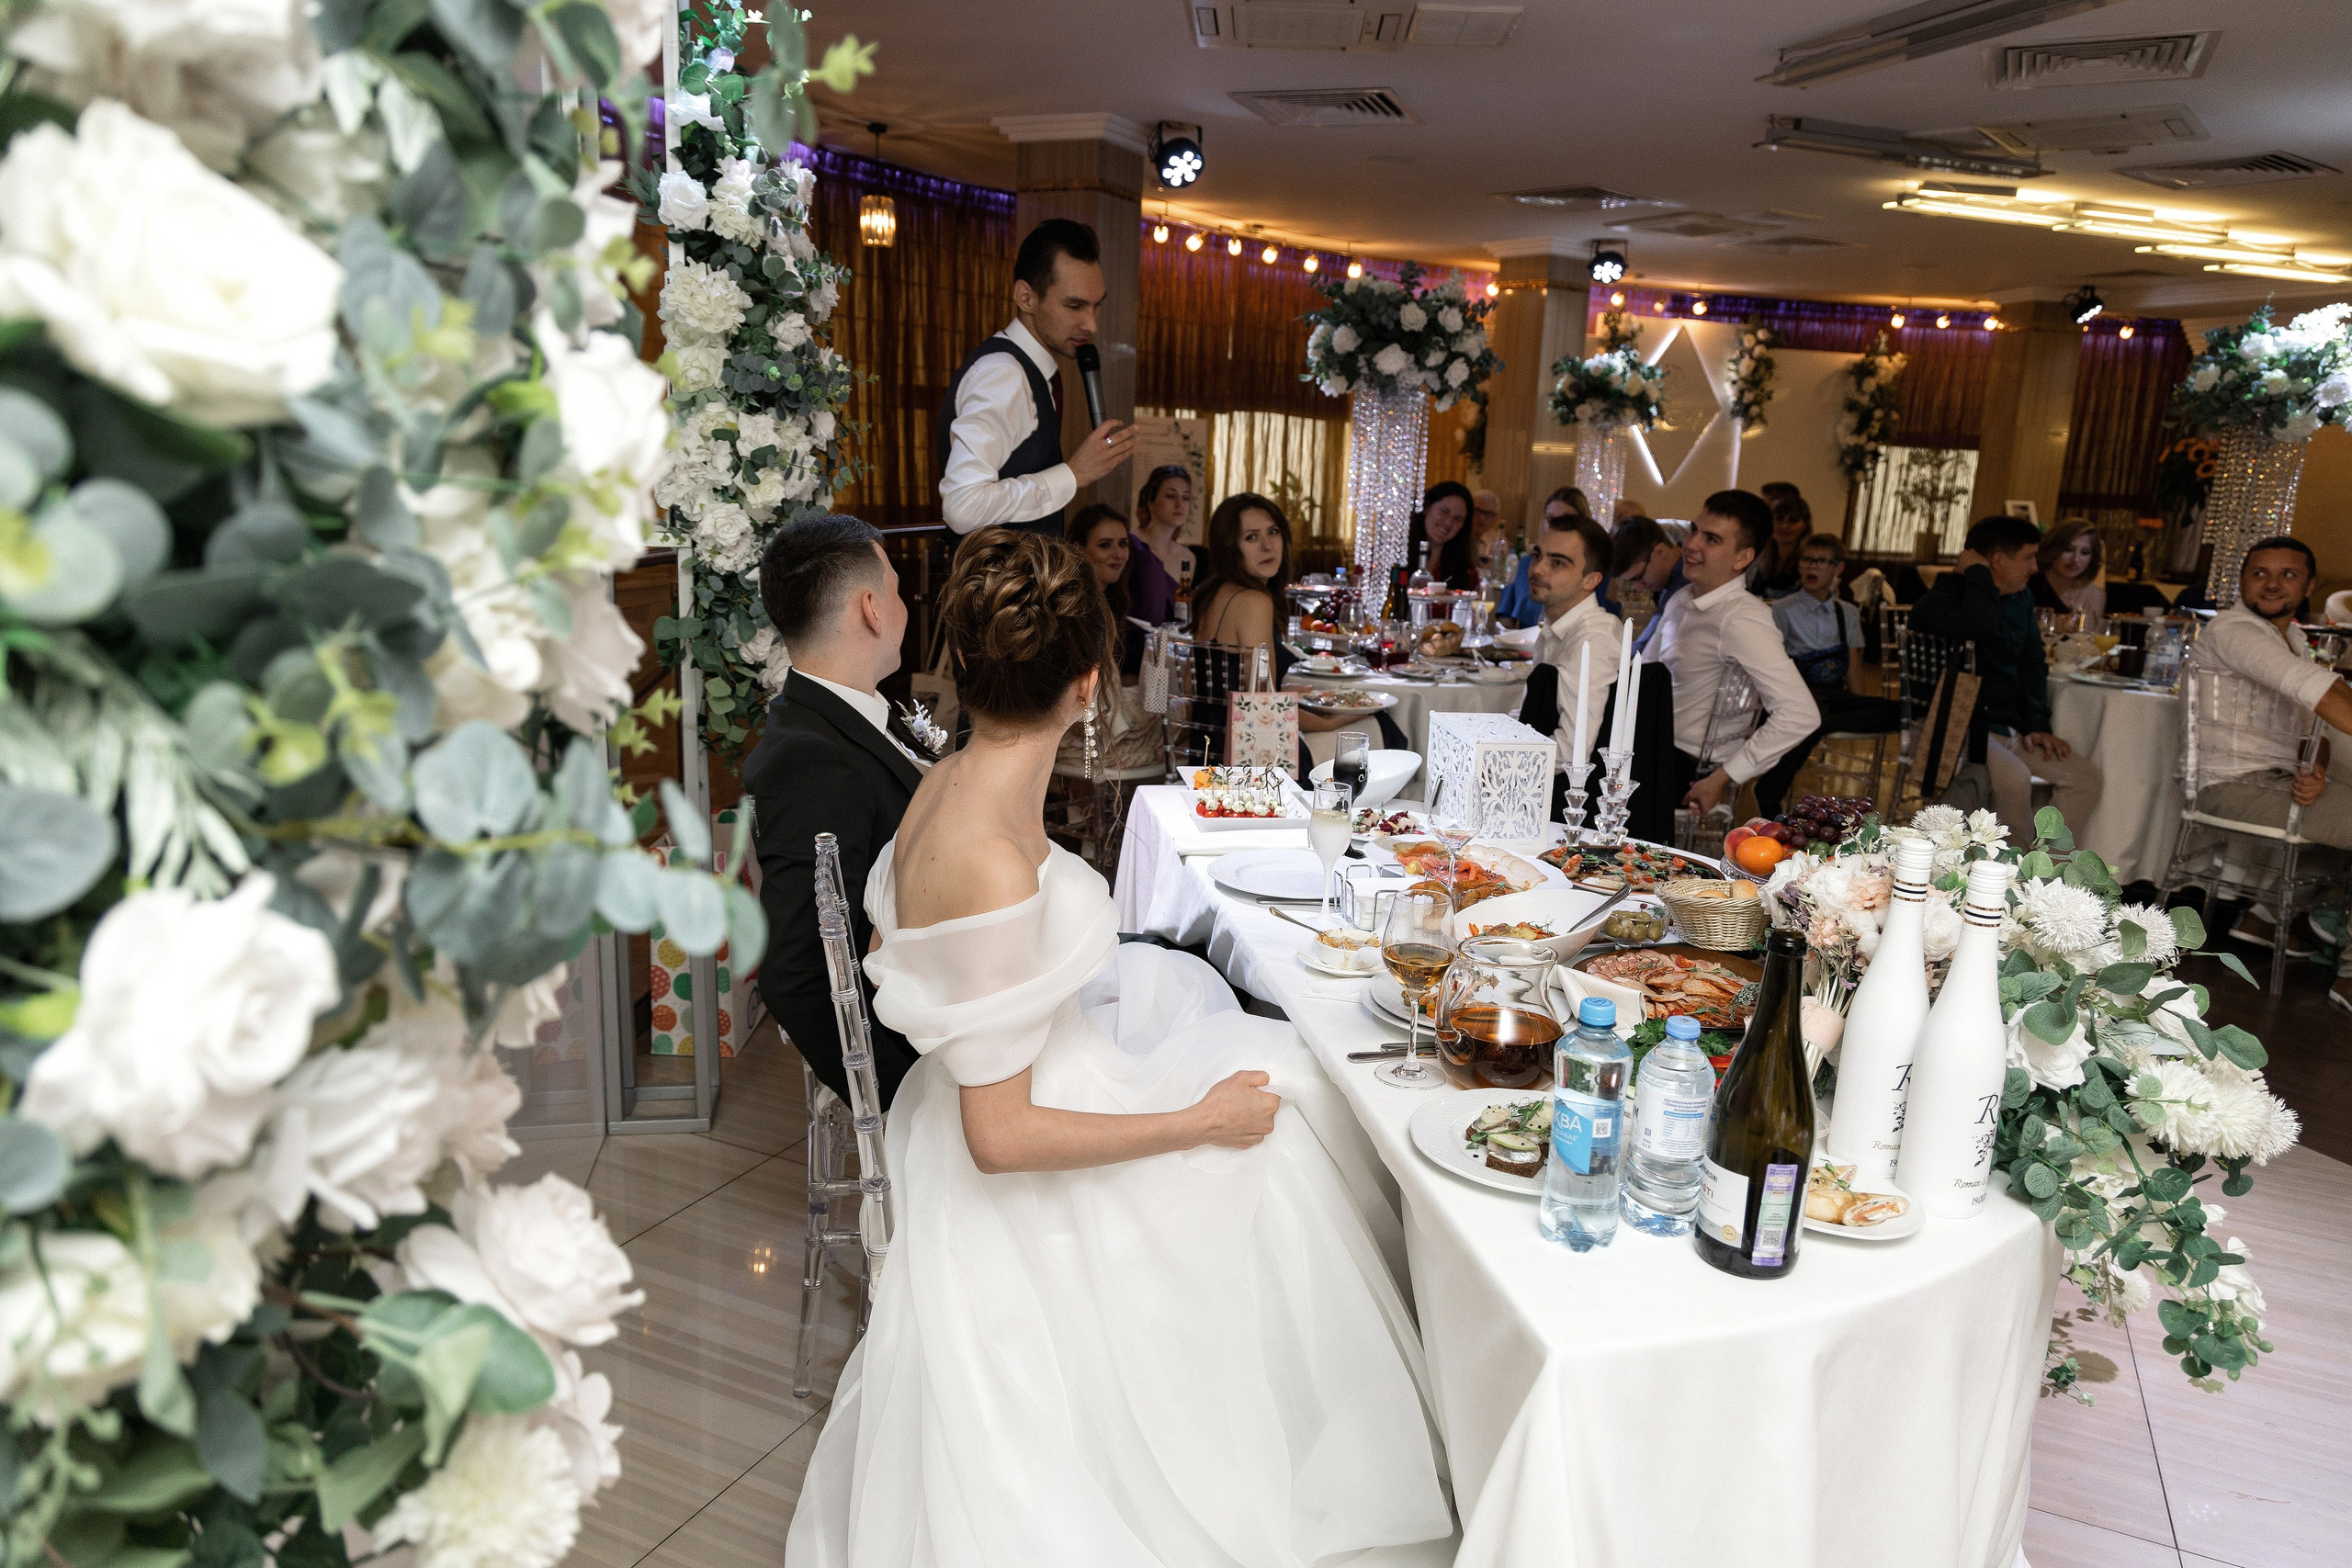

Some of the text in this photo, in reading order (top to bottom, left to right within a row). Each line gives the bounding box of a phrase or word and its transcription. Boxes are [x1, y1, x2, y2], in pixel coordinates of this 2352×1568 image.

[1973, 1092, 1999, 1125] R
[1871, 1140, 1901, 1150] Roman
[1953, 1178, 1981, 1189] Roman
